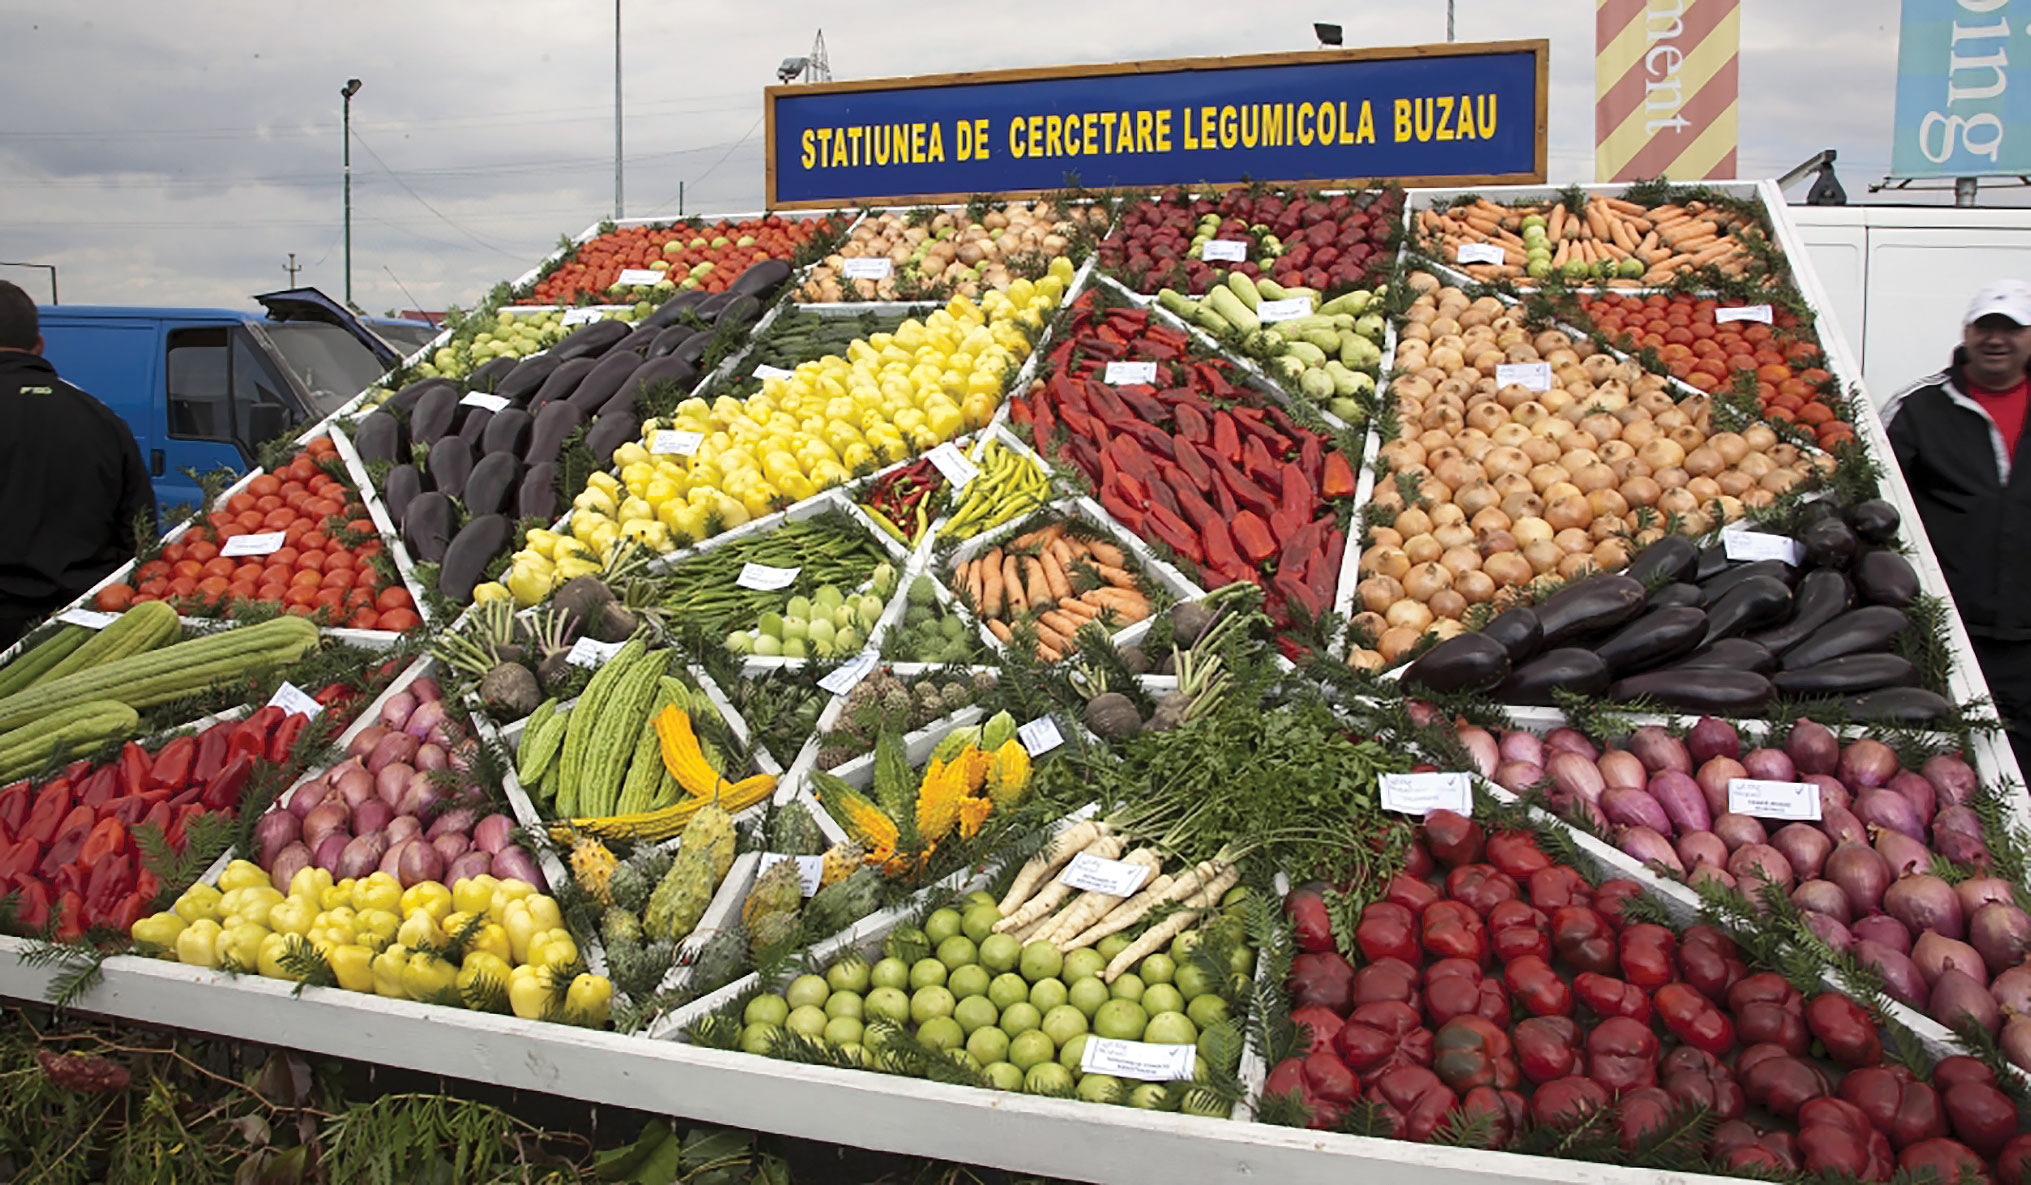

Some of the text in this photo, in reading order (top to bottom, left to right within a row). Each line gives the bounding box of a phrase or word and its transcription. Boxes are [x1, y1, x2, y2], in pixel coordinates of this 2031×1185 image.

[800, 93, 1498, 170] STATIUNEA DE CERCETARE LEGUMICOLA BUZAU
[1919, 0, 2031, 163] ing
